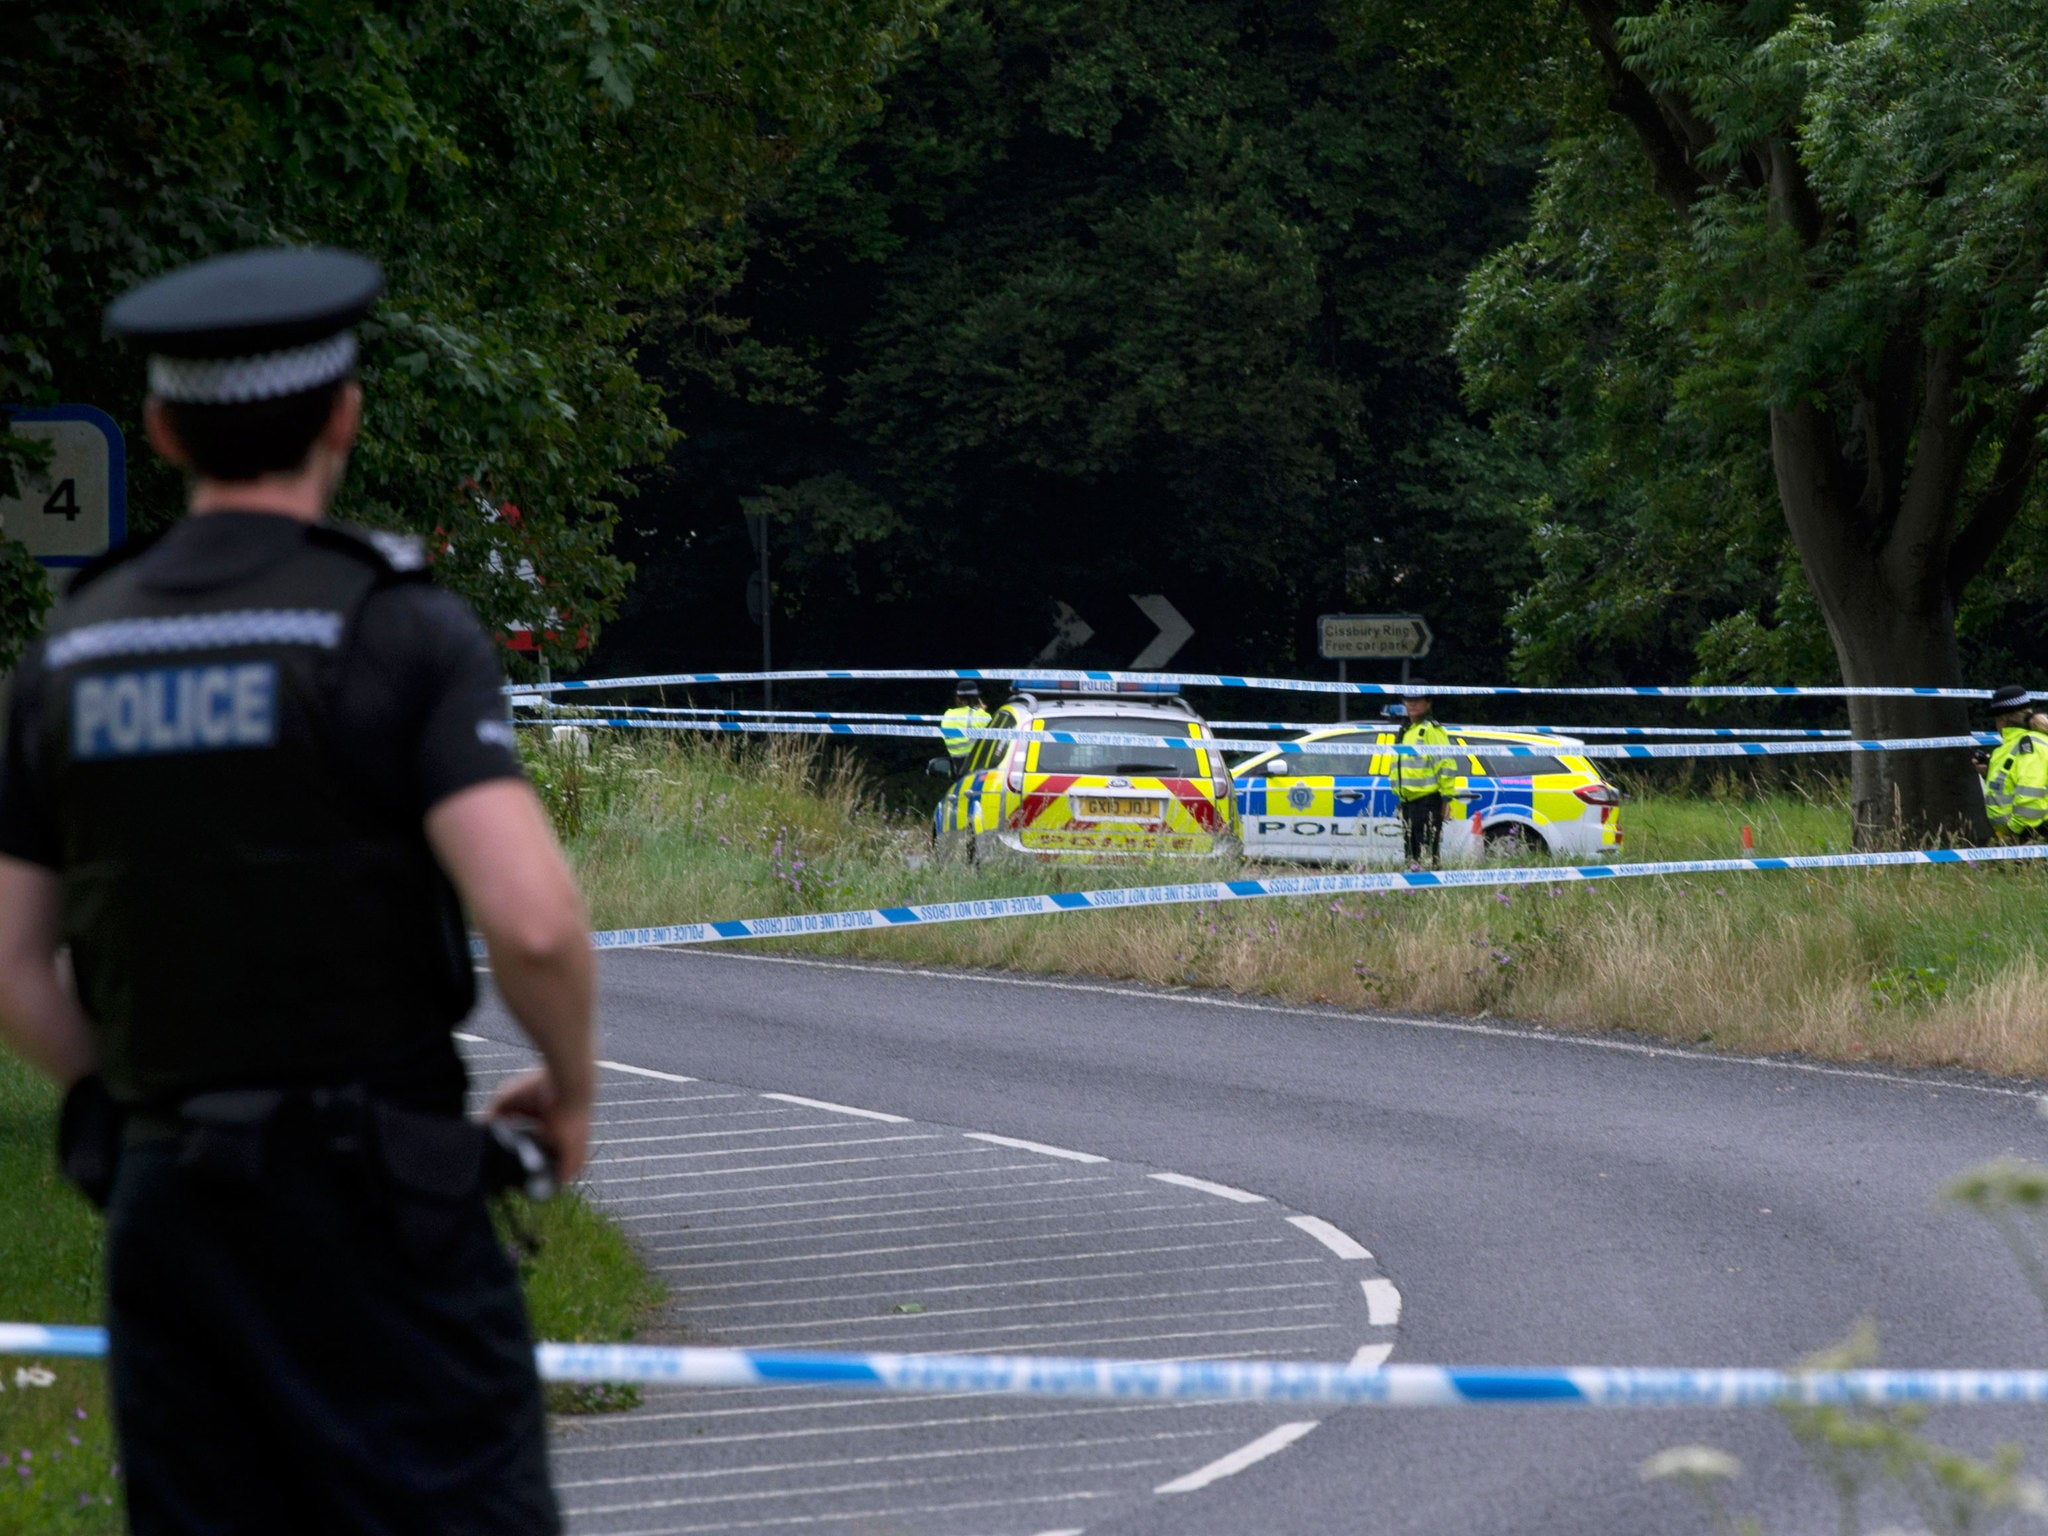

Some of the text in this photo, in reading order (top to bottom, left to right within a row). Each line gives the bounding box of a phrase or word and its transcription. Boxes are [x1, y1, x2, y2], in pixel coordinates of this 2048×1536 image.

[43, 478, 81, 521] 4
[1325, 625, 1410, 639] Cissbury Ring
[1325, 640, 1409, 652] Free car park
[1081, 679, 1115, 691] POLICE
[76, 664, 272, 755] POLICE
[1259, 821, 1406, 837] POLIC
[1094, 884, 1218, 906] POLICE LINE DO NOT CROSS
[921, 897, 1043, 920] POLICE LINE DO NOT CROSS
[753, 911, 872, 934] POLICE LINE DO NOT CROSS
[618, 930, 635, 945] NOT
[638, 929, 649, 943] DO
[653, 927, 671, 943] LINE
[674, 924, 704, 940] POLICE
